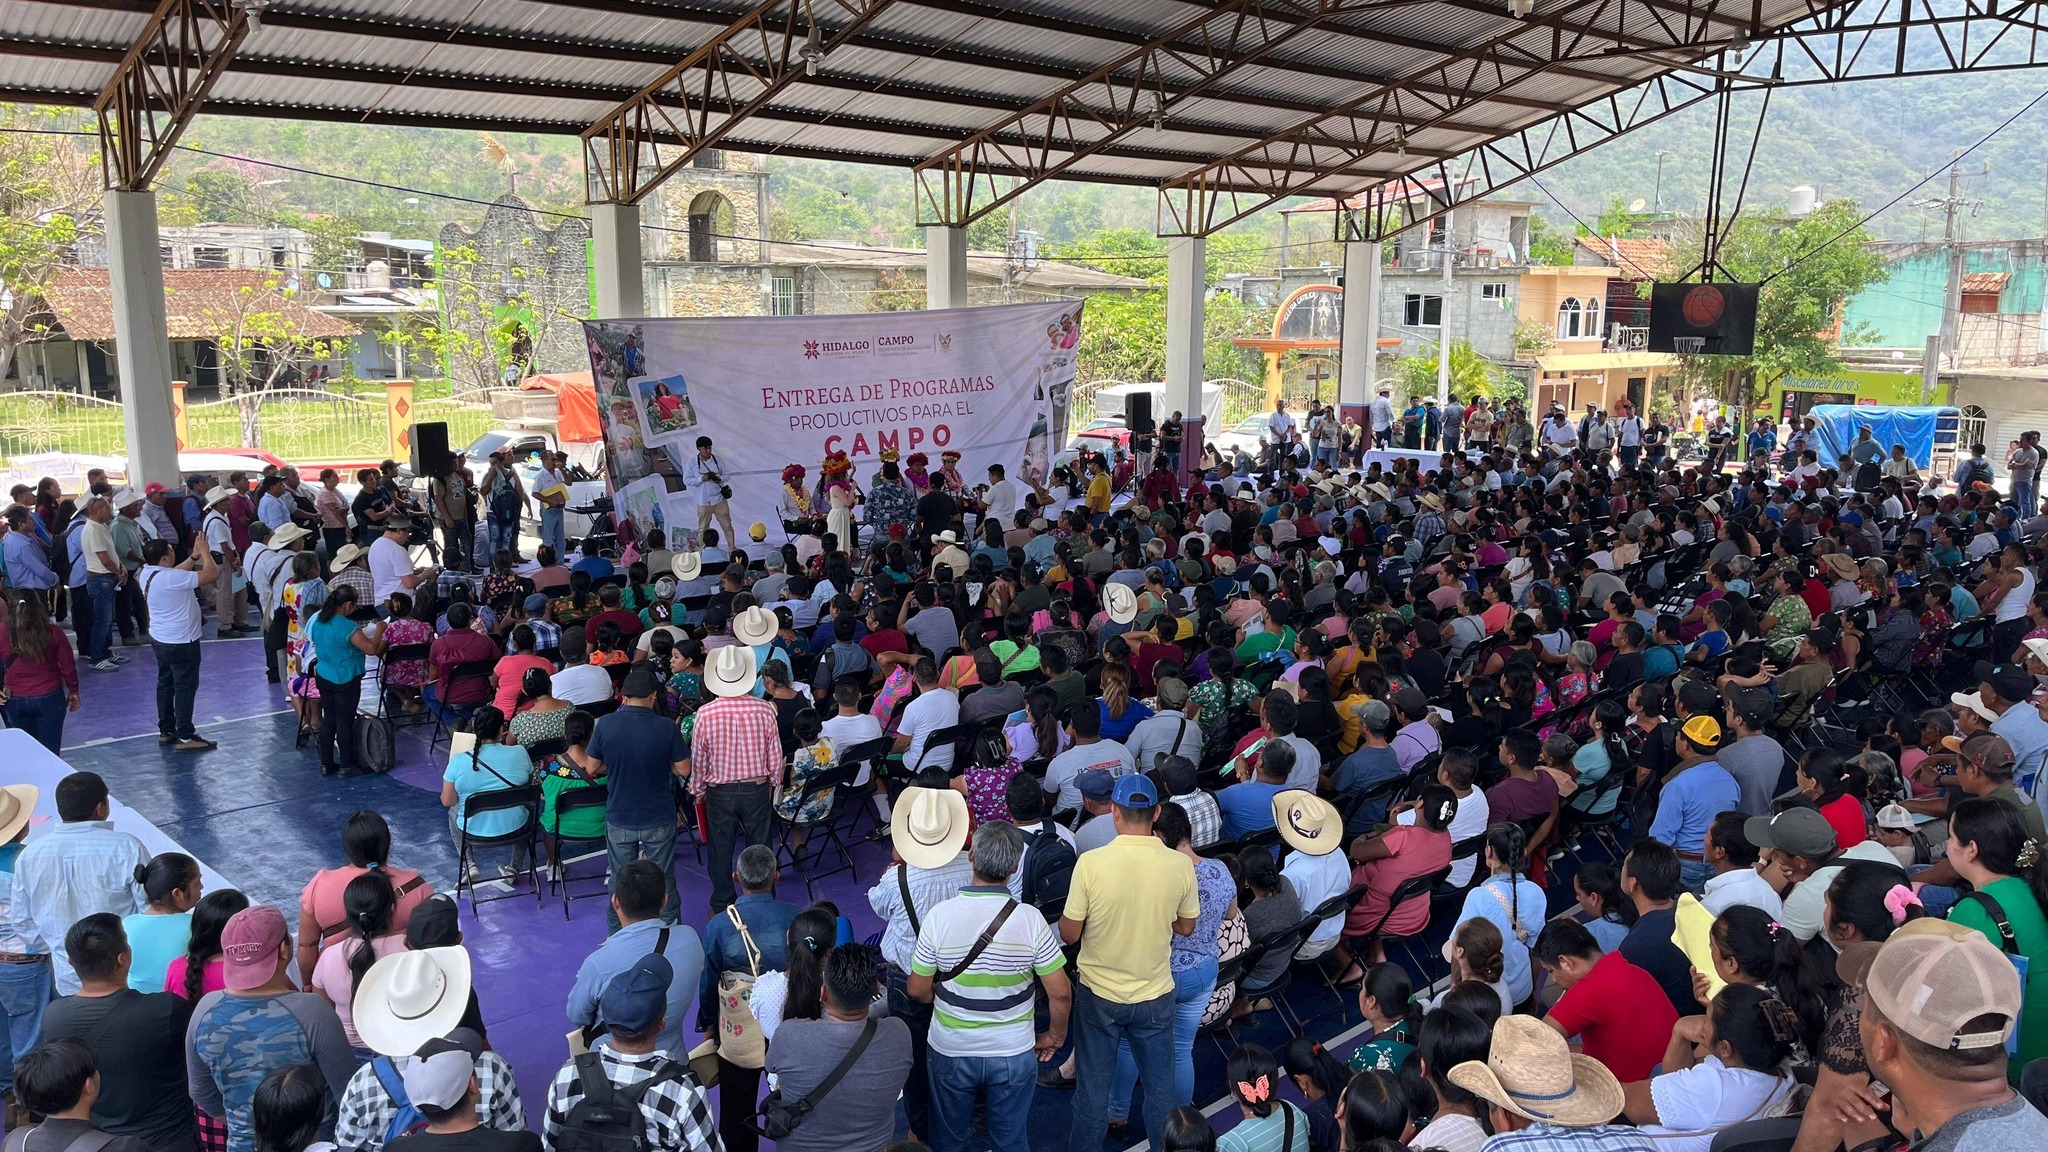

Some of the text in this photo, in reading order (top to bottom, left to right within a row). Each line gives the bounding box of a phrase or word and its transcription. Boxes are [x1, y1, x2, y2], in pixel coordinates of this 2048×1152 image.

[822, 341, 870, 352] HIDALGO
[878, 336, 914, 346] CAMPO
[761, 375, 995, 409] ENTREGA DE PROGRAMAS
[789, 400, 974, 431] PRODUCTIVOS PARA EL
[824, 424, 951, 457] CAMPO
